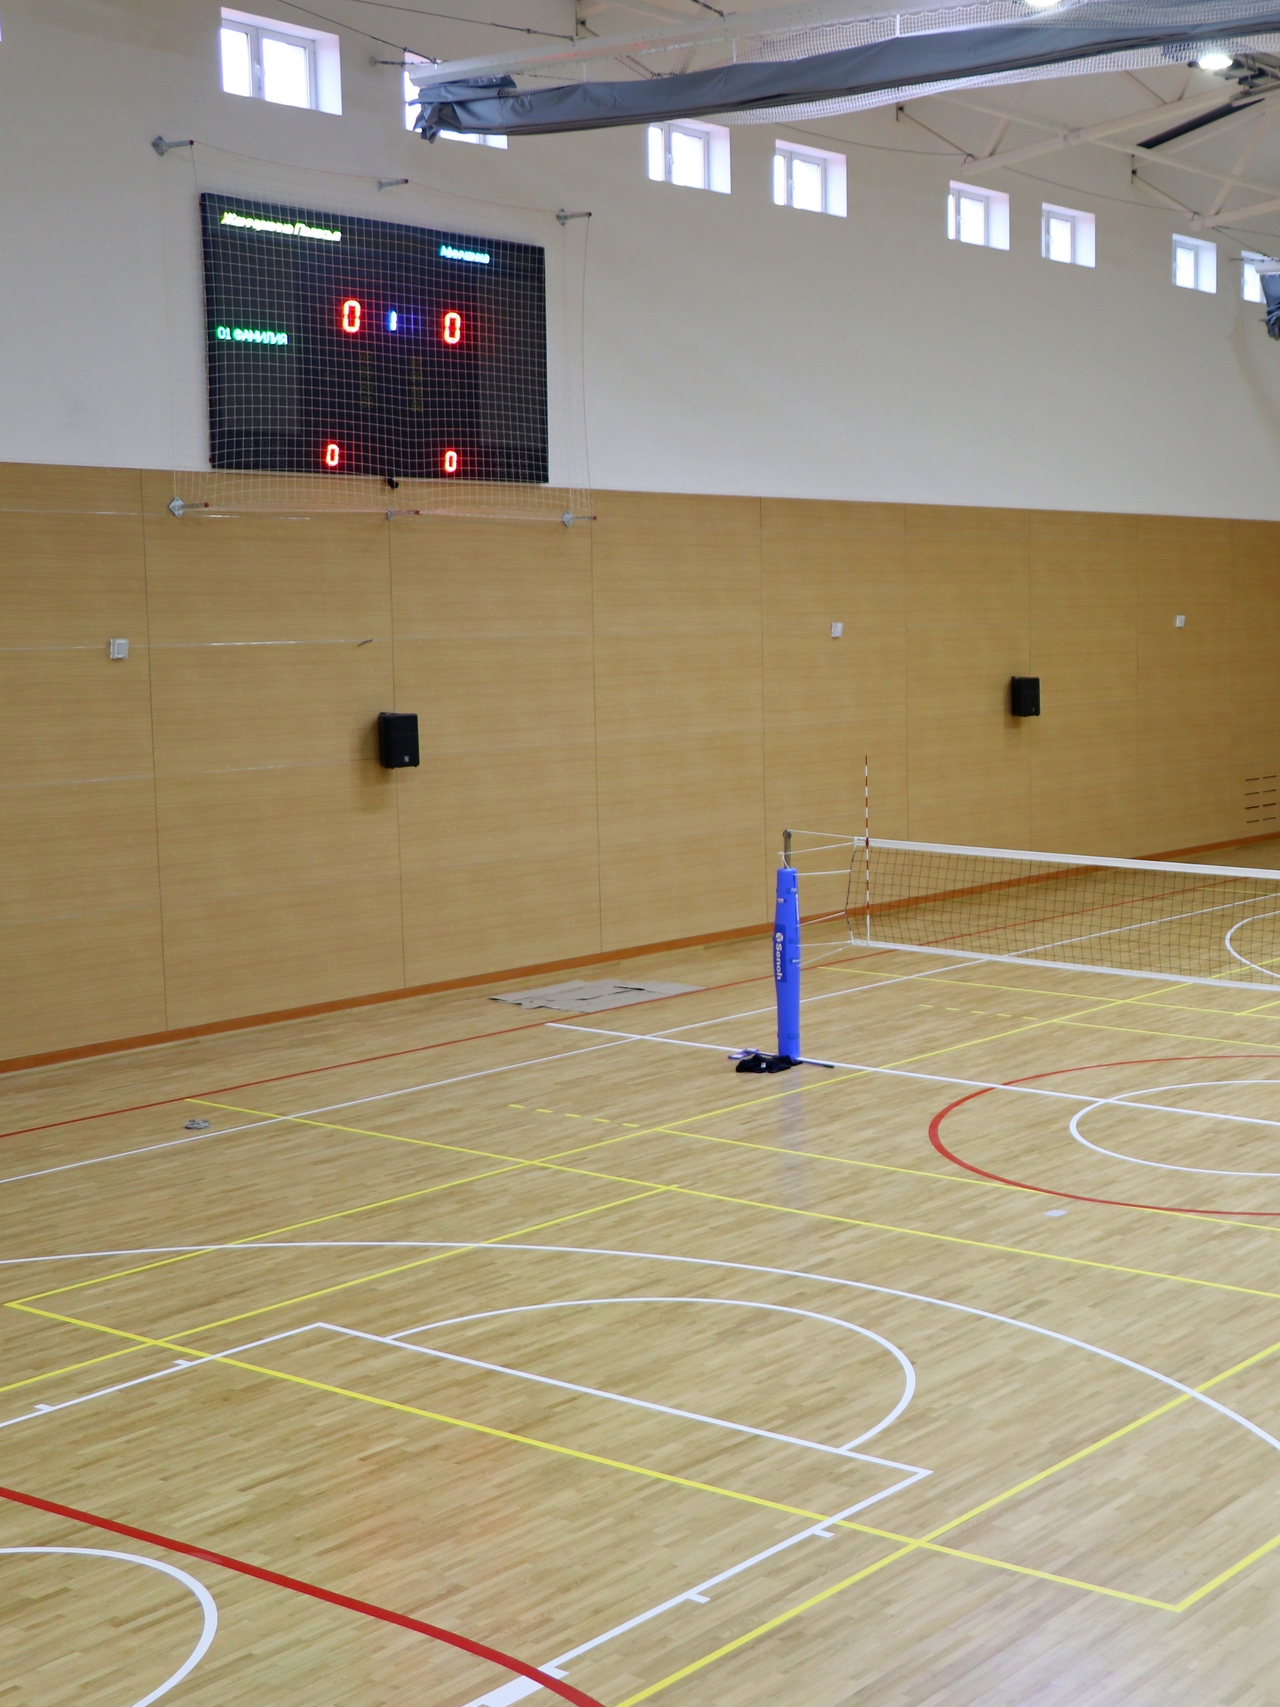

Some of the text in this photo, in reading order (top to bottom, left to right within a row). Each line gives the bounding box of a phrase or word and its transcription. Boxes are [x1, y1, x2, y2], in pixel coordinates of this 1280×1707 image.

[343, 299, 360, 334] 0
[389, 309, 397, 331] 1
[444, 312, 461, 345] 0
[216, 325, 232, 341] 01
[326, 443, 339, 467] 0
[445, 450, 457, 472] 0
[775, 943, 783, 980] Senoh
